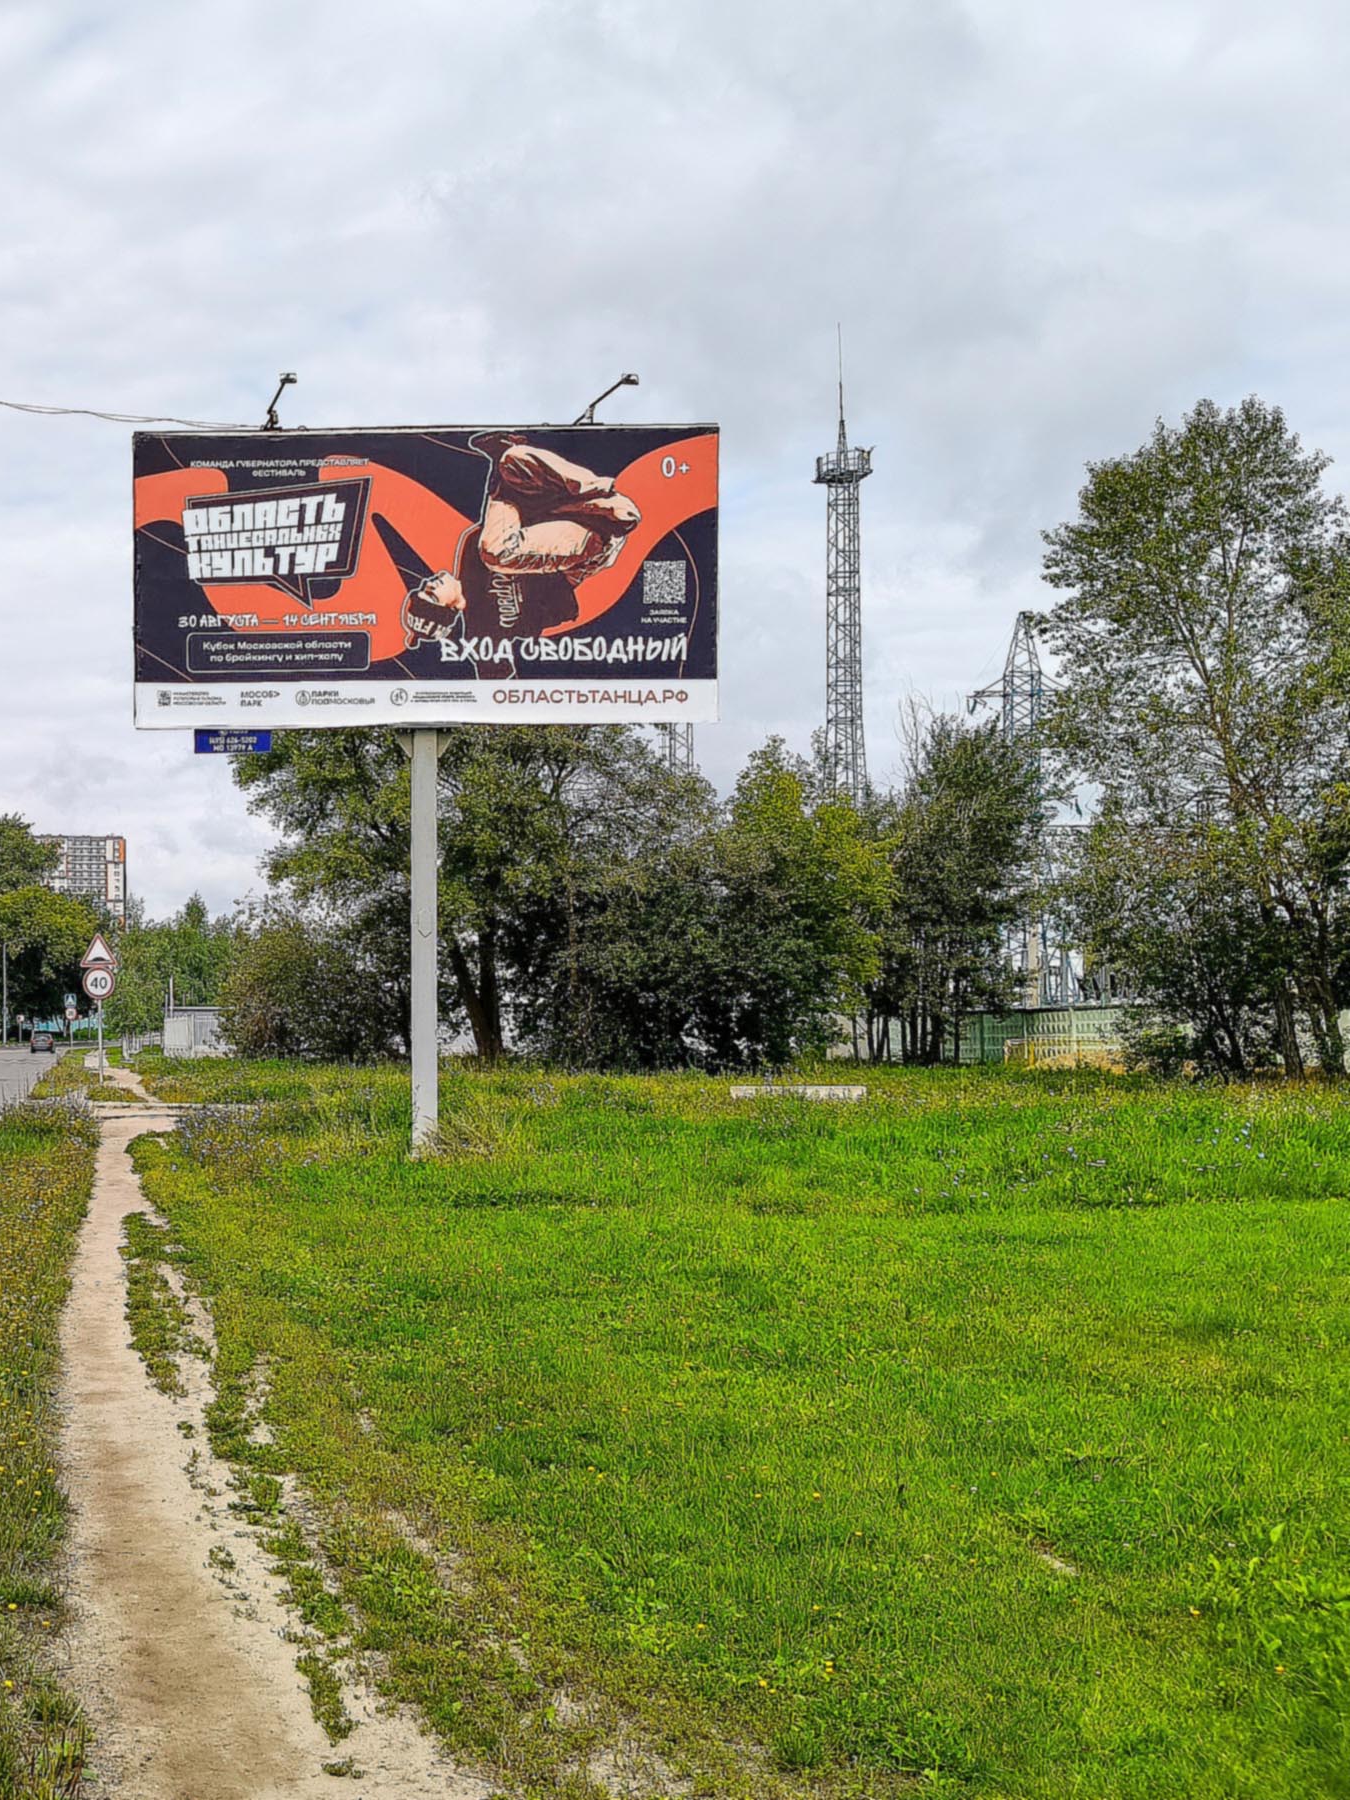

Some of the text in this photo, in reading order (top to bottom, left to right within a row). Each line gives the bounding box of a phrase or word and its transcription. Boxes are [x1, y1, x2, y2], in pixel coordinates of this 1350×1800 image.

[190, 458, 369, 468] КОМАНДА ГУБЕРНАТОРА ПРЕДСТАВЛЯЕТ
[661, 456, 690, 478] 0+
[252, 469, 306, 477] ФЕСТИВАЛЬ
[183, 493, 346, 536] ОБЛАСТЬ
[187, 542, 340, 580] КУЛЬТУР
[178, 615, 197, 628] 30
[199, 614, 259, 628] АВГУСТА
[282, 614, 298, 626] 14
[300, 613, 377, 627] СЕНТЯБРЯ
[203, 640, 352, 652] Кубок Московской области
[440, 633, 687, 663] ВХОД СВОБОДНЫЙ
[209, 654, 224, 662] по
[285, 654, 293, 662] и
[493, 689, 688, 706] ОБЛАСТЬТАНЦА.РФ
[90, 977, 108, 989] 40
